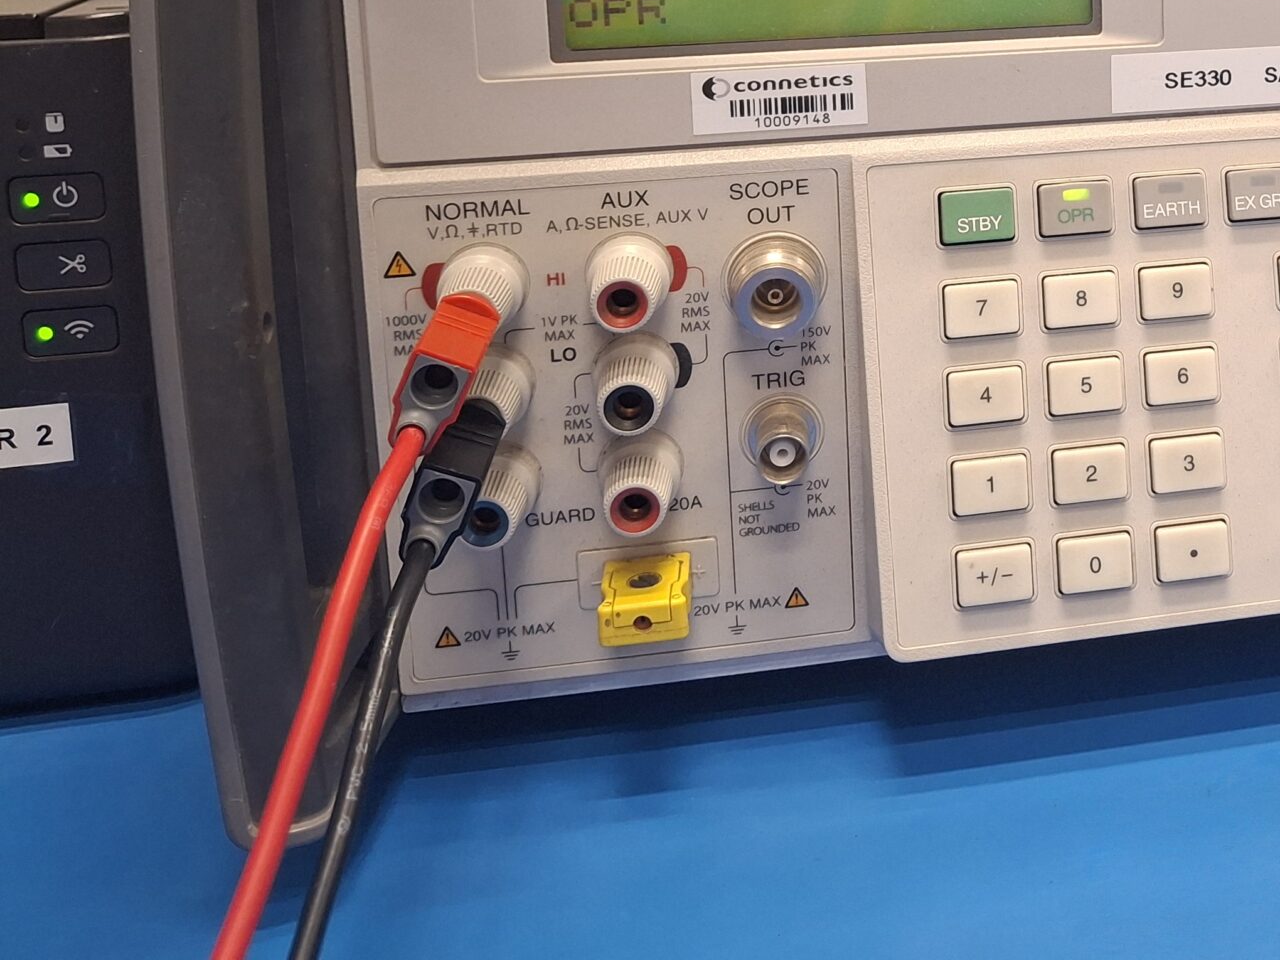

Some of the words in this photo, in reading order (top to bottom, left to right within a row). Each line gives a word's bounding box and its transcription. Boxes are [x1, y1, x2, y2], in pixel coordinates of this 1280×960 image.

[734, 72, 854, 93] connetics
[1165, 69, 1232, 89] SE330
[755, 113, 831, 128] 10009148
[729, 179, 810, 200] SCOPE
[601, 190, 650, 209] AUX
[1235, 195, 1256, 211] EX
[425, 199, 530, 221] NORMAL
[656, 210, 692, 224] AUX
[747, 205, 796, 225] OUT
[1057, 208, 1095, 224] OPR
[1143, 200, 1201, 219] EARTH
[957, 215, 1002, 233] STBY
[546, 273, 566, 286] HI
[685, 292, 710, 304] 20V
[682, 306, 711, 317] RMS
[385, 314, 427, 327] 1000V
[561, 315, 578, 326] PK
[680, 321, 711, 333] MAX
[545, 330, 575, 341] MAX
[800, 341, 817, 352] PK
[550, 347, 577, 362] LO
[801, 354, 831, 366] MAX
[752, 370, 806, 390] TRIG
[565, 404, 590, 417] 20V
[564, 417, 593, 430] RMS
[36, 424, 54, 447] 2
[563, 432, 594, 445] MAX
[806, 478, 830, 491] 20V
[669, 496, 703, 512] 20A
[738, 500, 775, 513] SHELLS
[806, 493, 823, 505] PK
[525, 507, 596, 528] GUARD
[807, 505, 837, 518] MAX
[738, 514, 761, 525] NOT
[739, 521, 801, 538] GROUNDED
[694, 603, 720, 617] 20V
[724, 599, 746, 613] PK
[749, 595, 782, 609] MAX
[464, 629, 493, 643] 20V
[497, 626, 519, 640] PK
[522, 621, 556, 636] MAX
